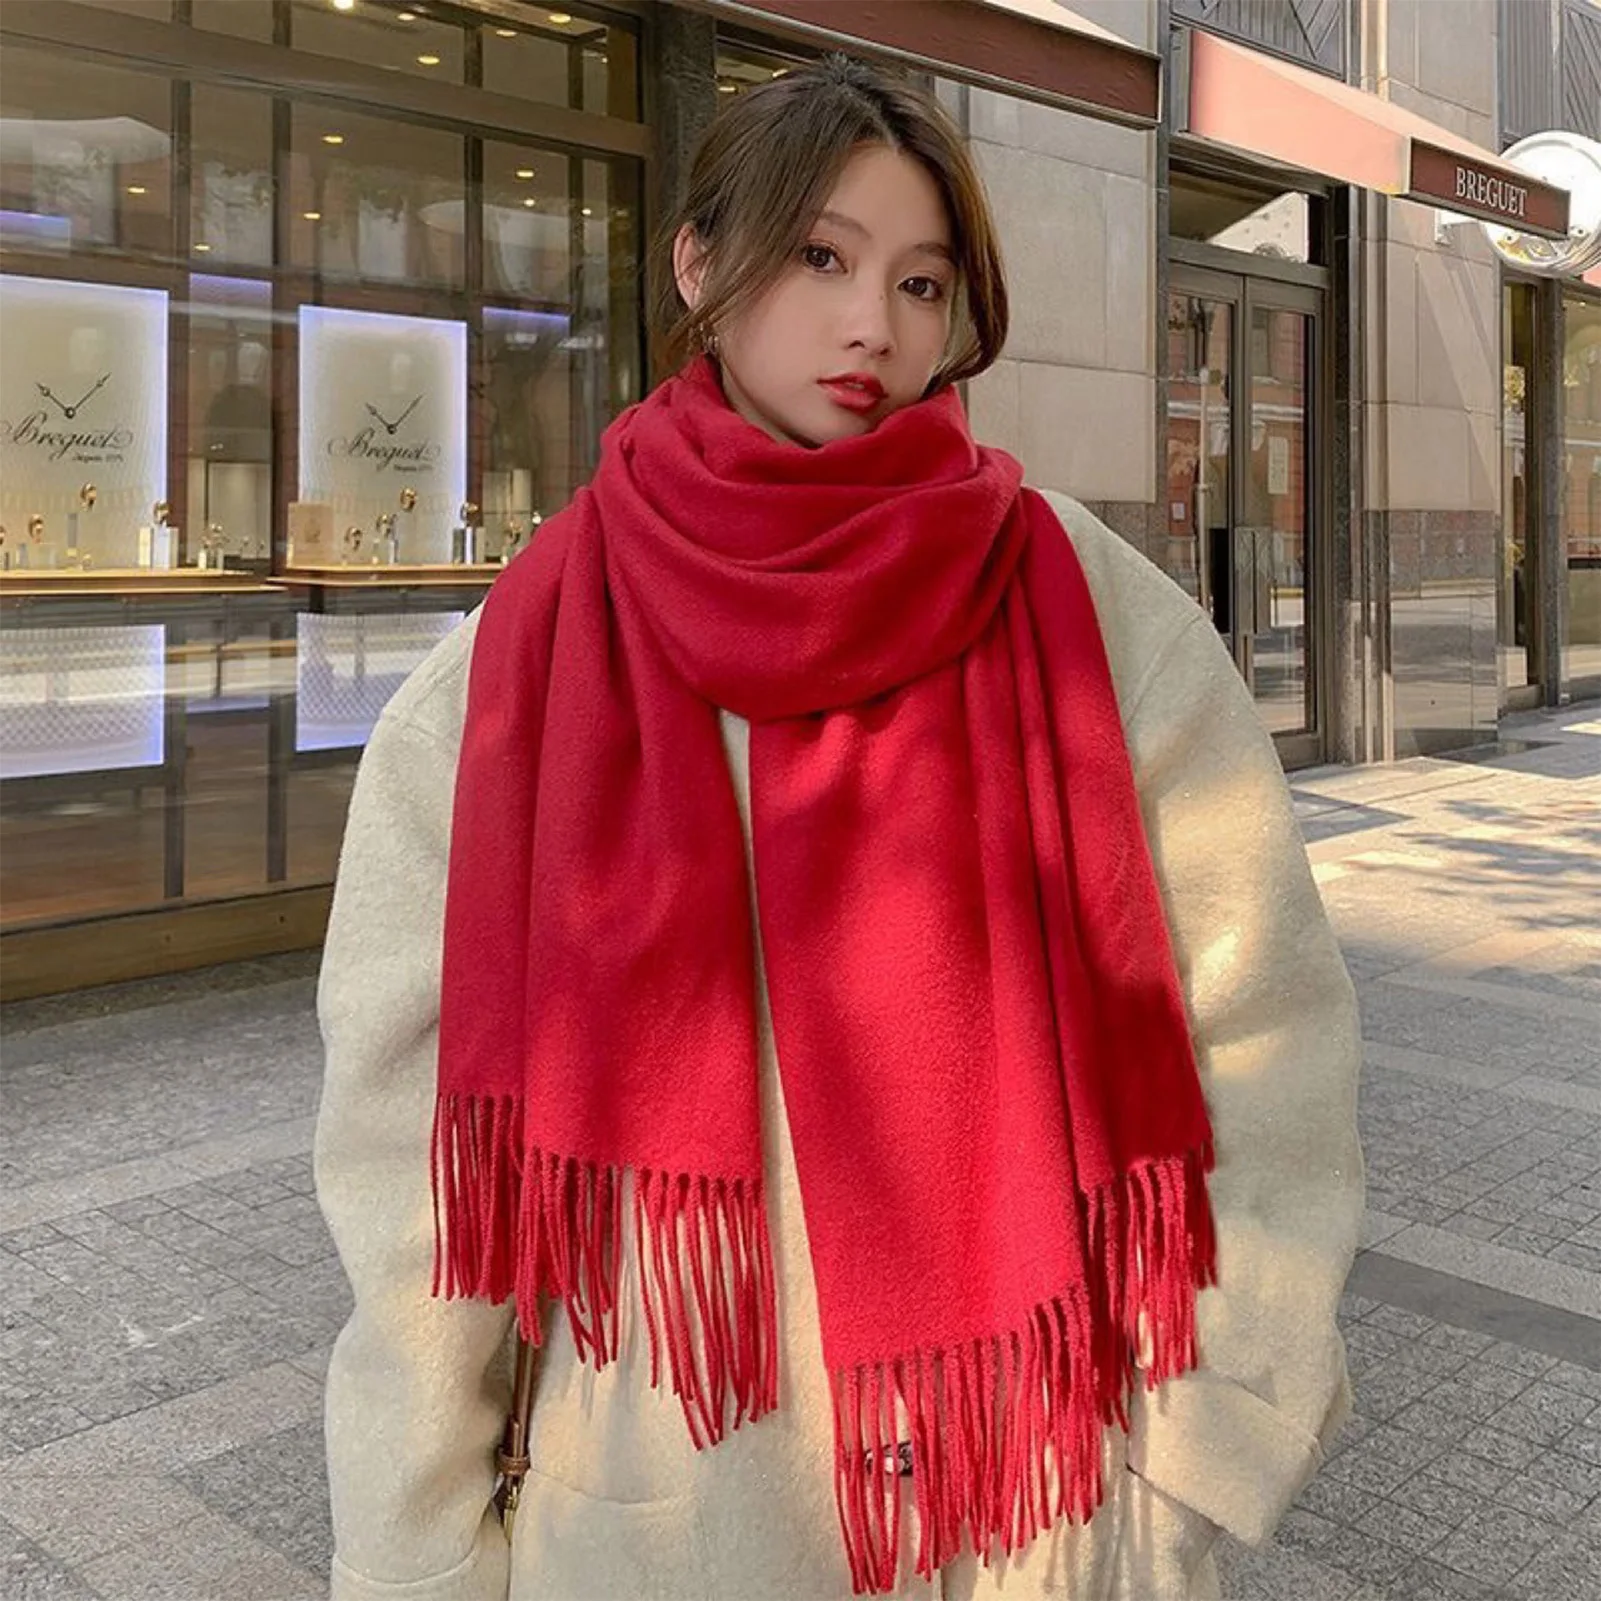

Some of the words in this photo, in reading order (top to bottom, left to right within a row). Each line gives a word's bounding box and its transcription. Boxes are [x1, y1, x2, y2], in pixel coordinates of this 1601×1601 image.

[1456, 167, 1527, 216] BREGUET
[2, 411, 133, 461] Breguet
[328, 427, 441, 471] Breguet
